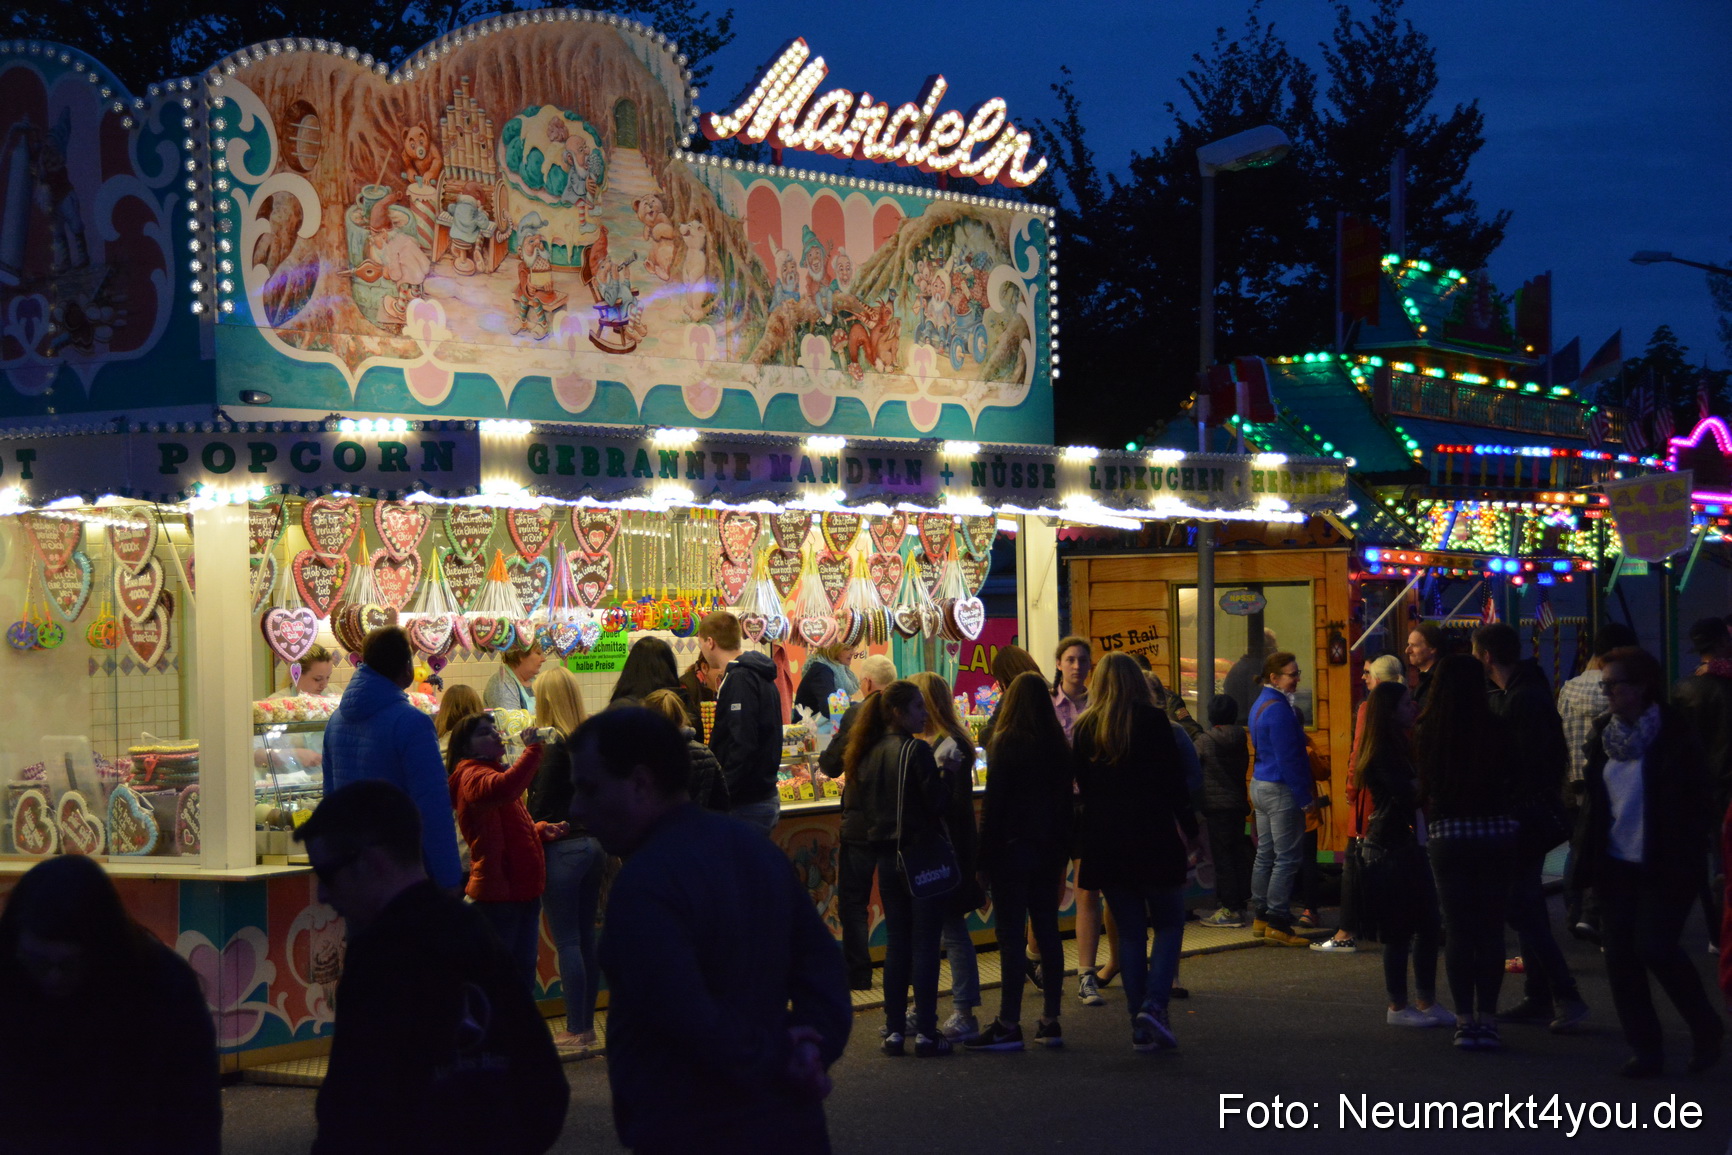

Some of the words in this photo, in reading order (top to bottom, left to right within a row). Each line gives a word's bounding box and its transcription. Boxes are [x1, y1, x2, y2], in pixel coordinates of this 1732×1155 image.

[702, 36, 1047, 188] Mandeln
[158, 440, 456, 475] POPCORN
[527, 442, 752, 481] GEBRANNTE
[769, 452, 921, 487] MANDELN
[970, 456, 1056, 489] NÜSSE
[1089, 465, 1224, 493] LEBKUCHEN
[1100, 634, 1123, 651] US
[1127, 625, 1160, 646] Rail
[1125, 643, 1160, 657] perty
[575, 661, 594, 671] halbe
[595, 660, 615, 670] Preise
[914, 868, 941, 886] adidas
